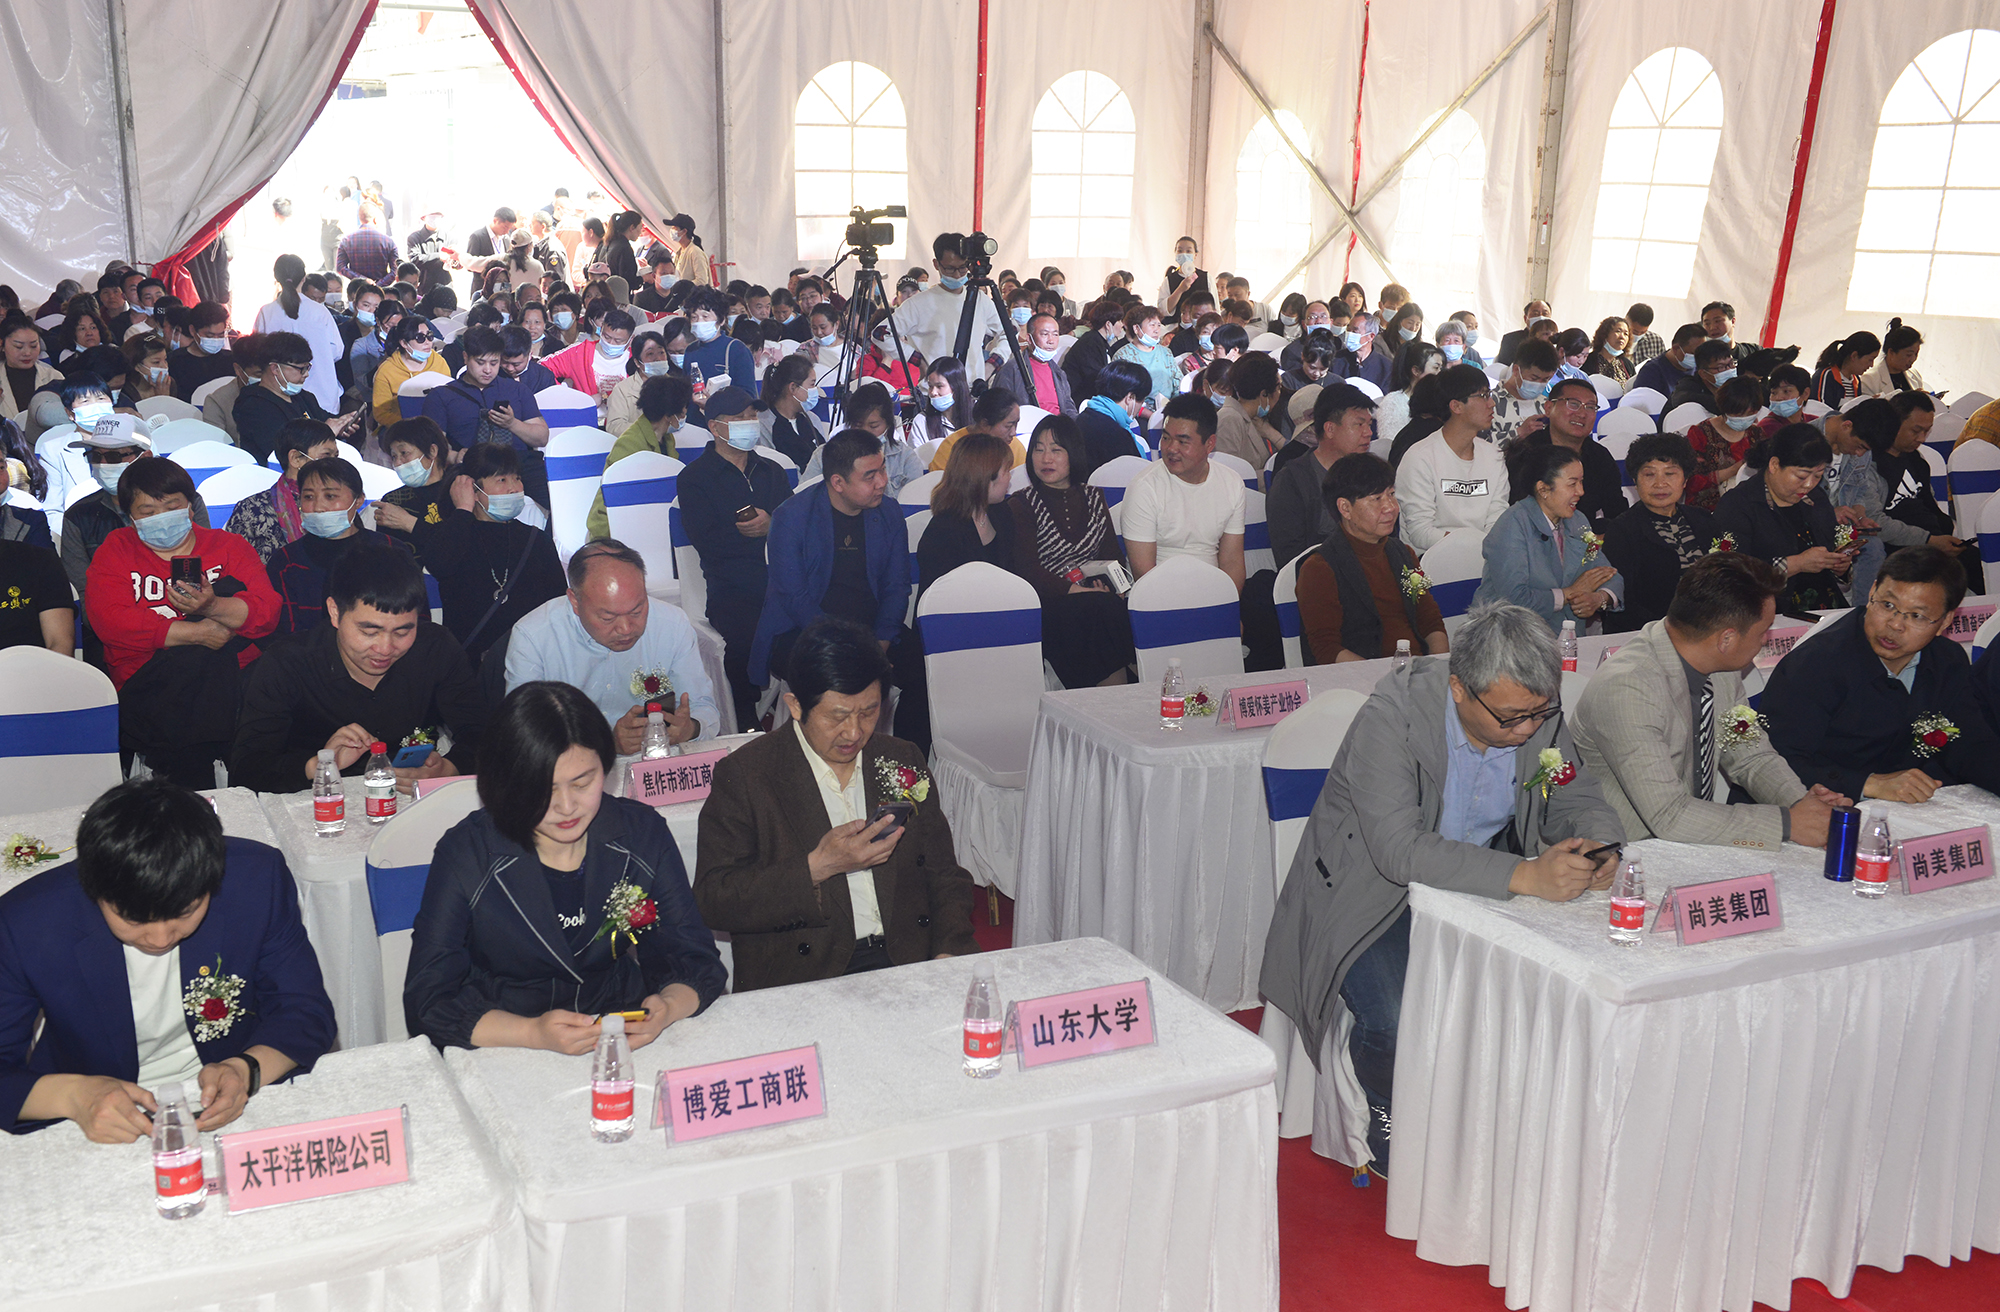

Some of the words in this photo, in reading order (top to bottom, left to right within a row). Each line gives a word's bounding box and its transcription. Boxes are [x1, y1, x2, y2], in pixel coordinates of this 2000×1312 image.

[1238, 690, 1302, 719] 博爱怀姜产业协会
[642, 761, 718, 798] 焦作市浙江商
[1911, 839, 1984, 881] 尚美集团
[1687, 887, 1771, 930] 尚美集团
[1032, 997, 1139, 1048] 山东大学
[682, 1064, 809, 1124] 博爱工商联
[239, 1129, 392, 1192] 太平洋保险公司
